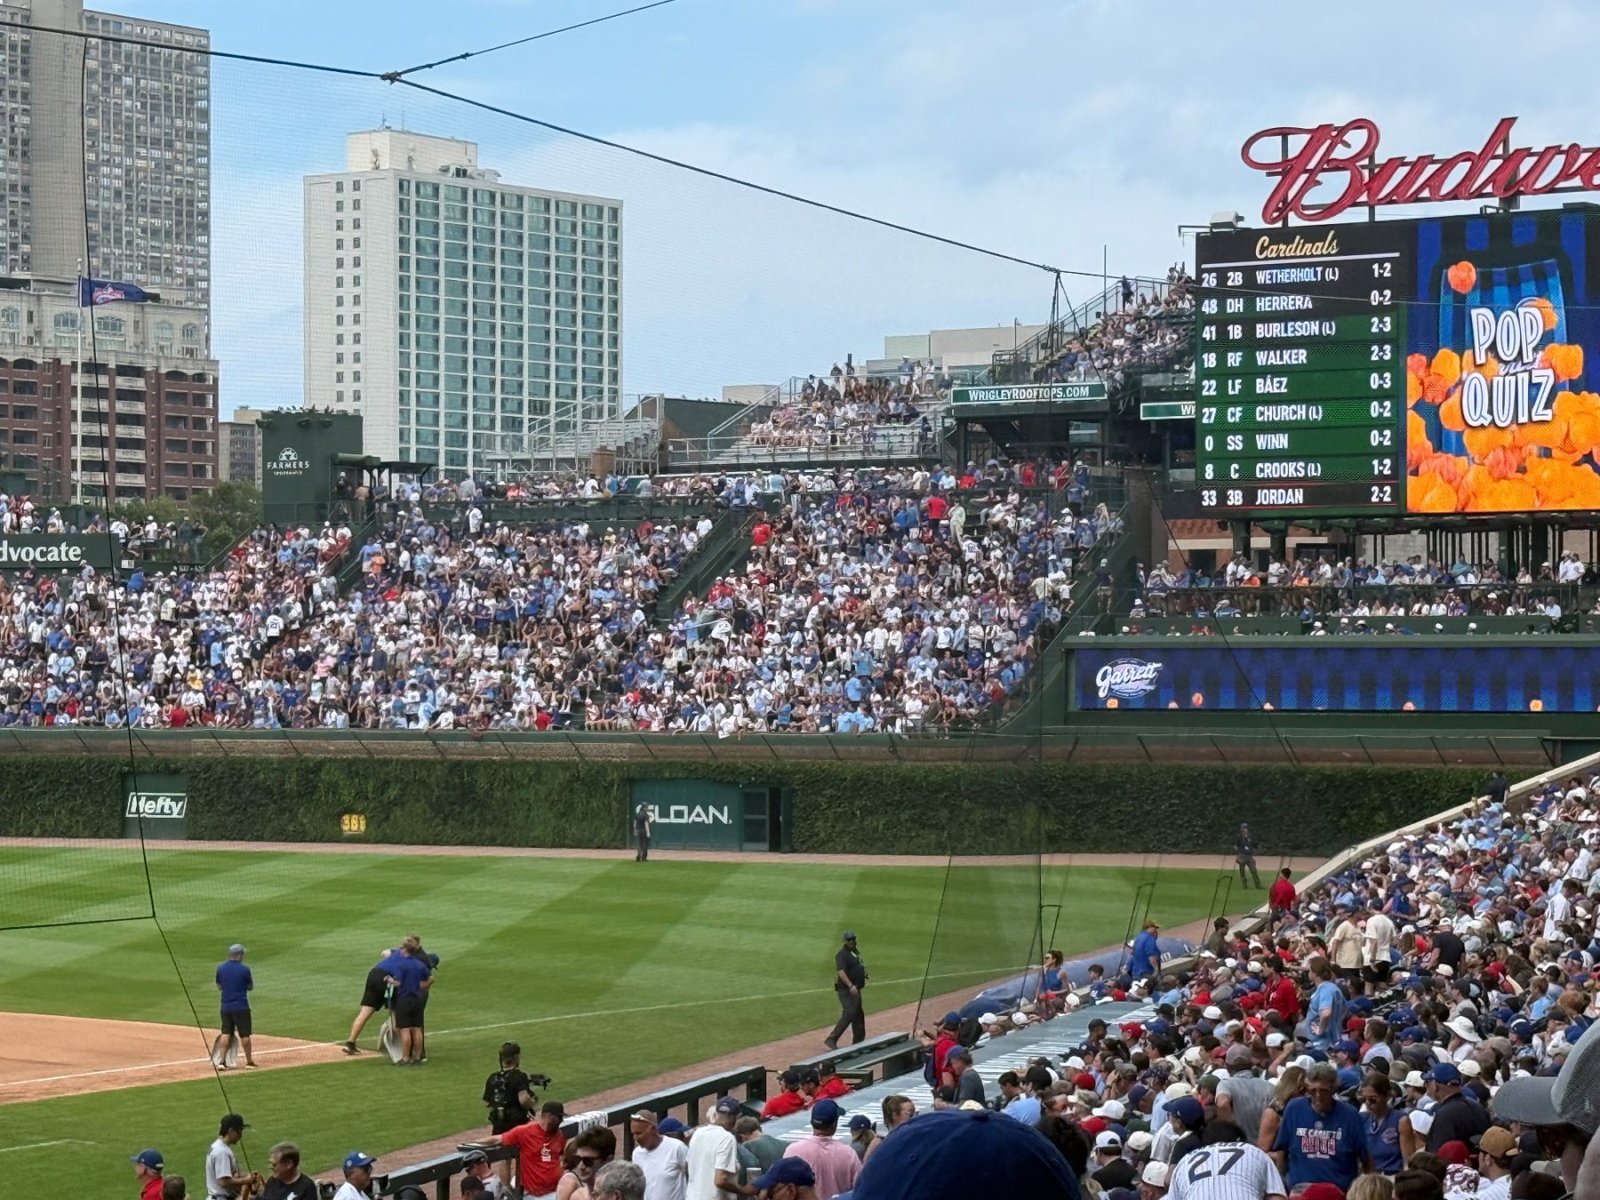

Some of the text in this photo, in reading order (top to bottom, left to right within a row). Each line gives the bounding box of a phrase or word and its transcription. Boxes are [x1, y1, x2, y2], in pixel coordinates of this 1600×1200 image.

[1255, 230, 1339, 259] Cardinals
[1201, 262, 1392, 287] 26 2B WETHERHOLT (L) 1-2
[1201, 290, 1392, 314] 48 DH HERRERA 0-2
[1202, 317, 1391, 341] 41 1B BURLESON (L) 2-3
[1470, 307, 1544, 366] POP
[1202, 345, 1391, 368] 18 RF WALKER 2-3
[968, 386, 1090, 401] WRIGLEYROOFTOPS.COM
[1201, 372, 1391, 396] 22 LF BÁEZ 0-3
[1461, 368, 1555, 428] QUIZ
[1201, 401, 1391, 424] 27 CF CHURCH (L) 0-2
[1204, 429, 1391, 451] 0 SS WINN 0-2
[266, 460, 310, 470] FARMERS
[1204, 458, 1391, 480] 8 C CROOKS (L) 1-2
[1201, 485, 1391, 506] 33 3B JORDAN 2-2
[130, 795, 184, 817] Hefty
[635, 804, 729, 824] SLOAN
[1188, 1147, 1246, 1186] 27
